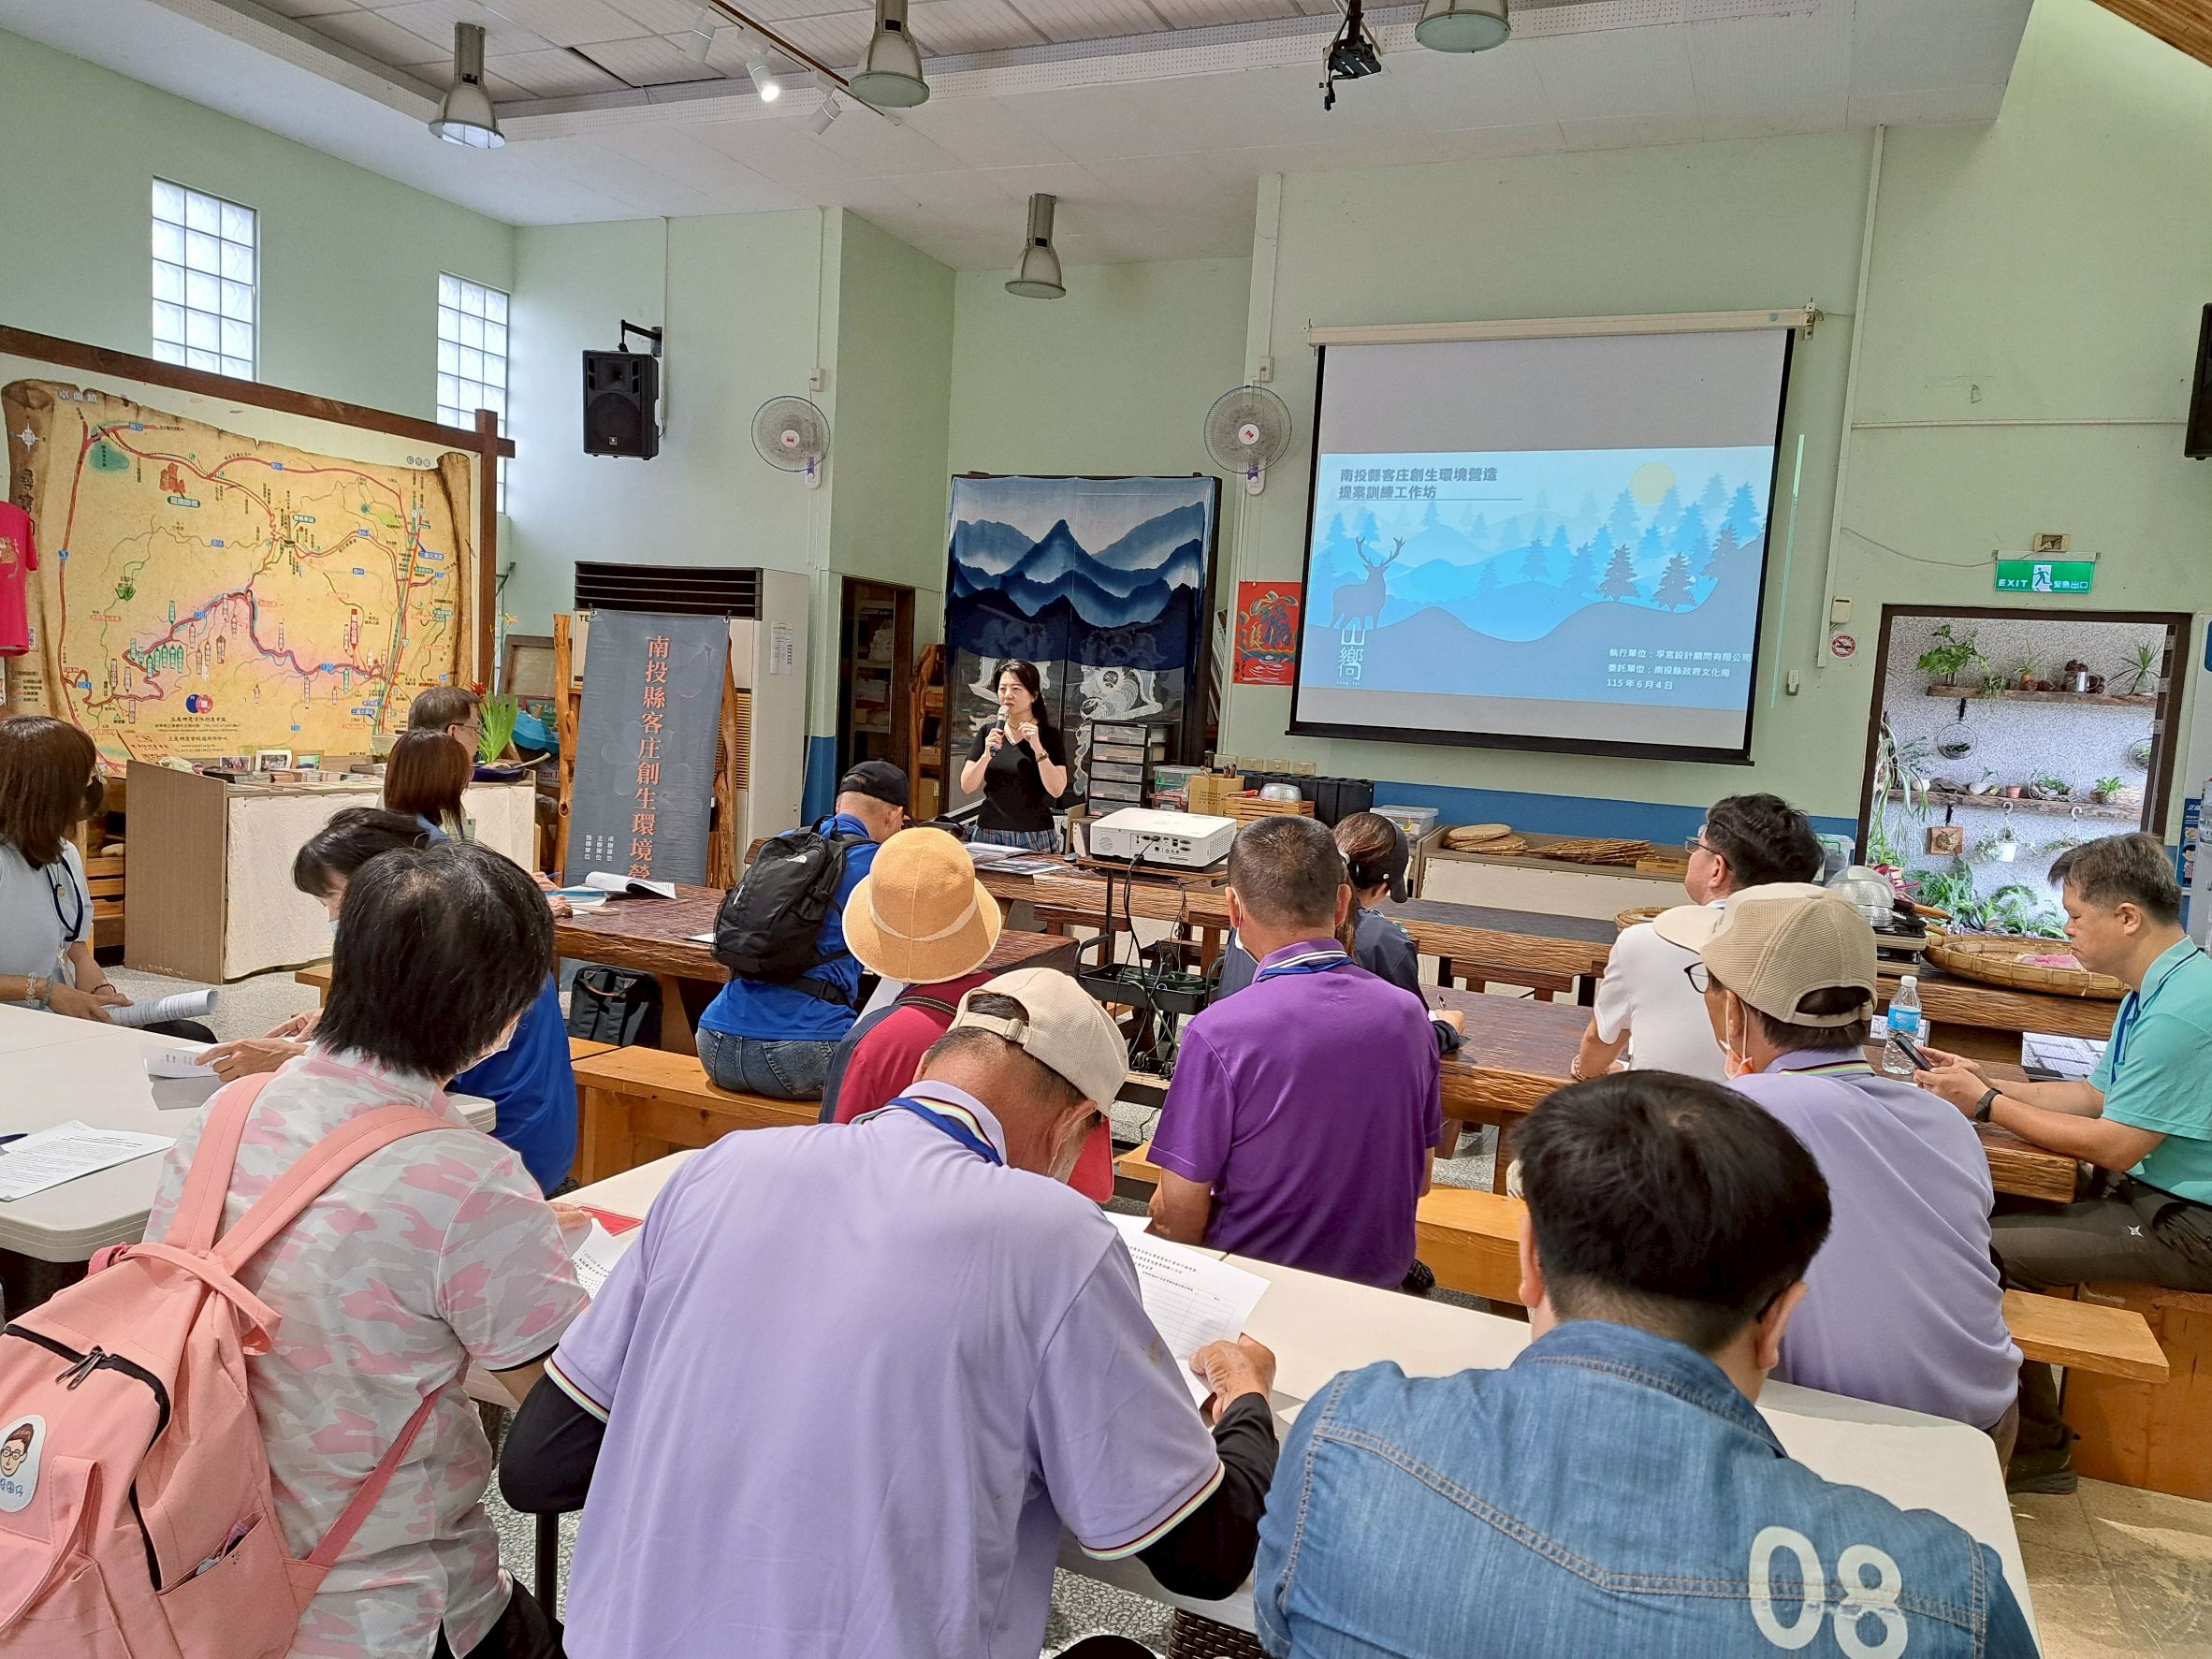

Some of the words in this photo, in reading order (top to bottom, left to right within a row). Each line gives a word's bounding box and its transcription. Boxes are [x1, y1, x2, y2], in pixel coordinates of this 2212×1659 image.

[1340, 467, 1498, 483] 南投縣客庄創生環境營造
[1338, 485, 1436, 500] 提案訓練工作坊
[1998, 579, 2028, 588] EXIT
[2053, 580, 2088, 589] 緊急出口
[1608, 663, 1731, 678] 委託單位：南投縣政府文化局
[1748, 1525, 1909, 1659] 08
